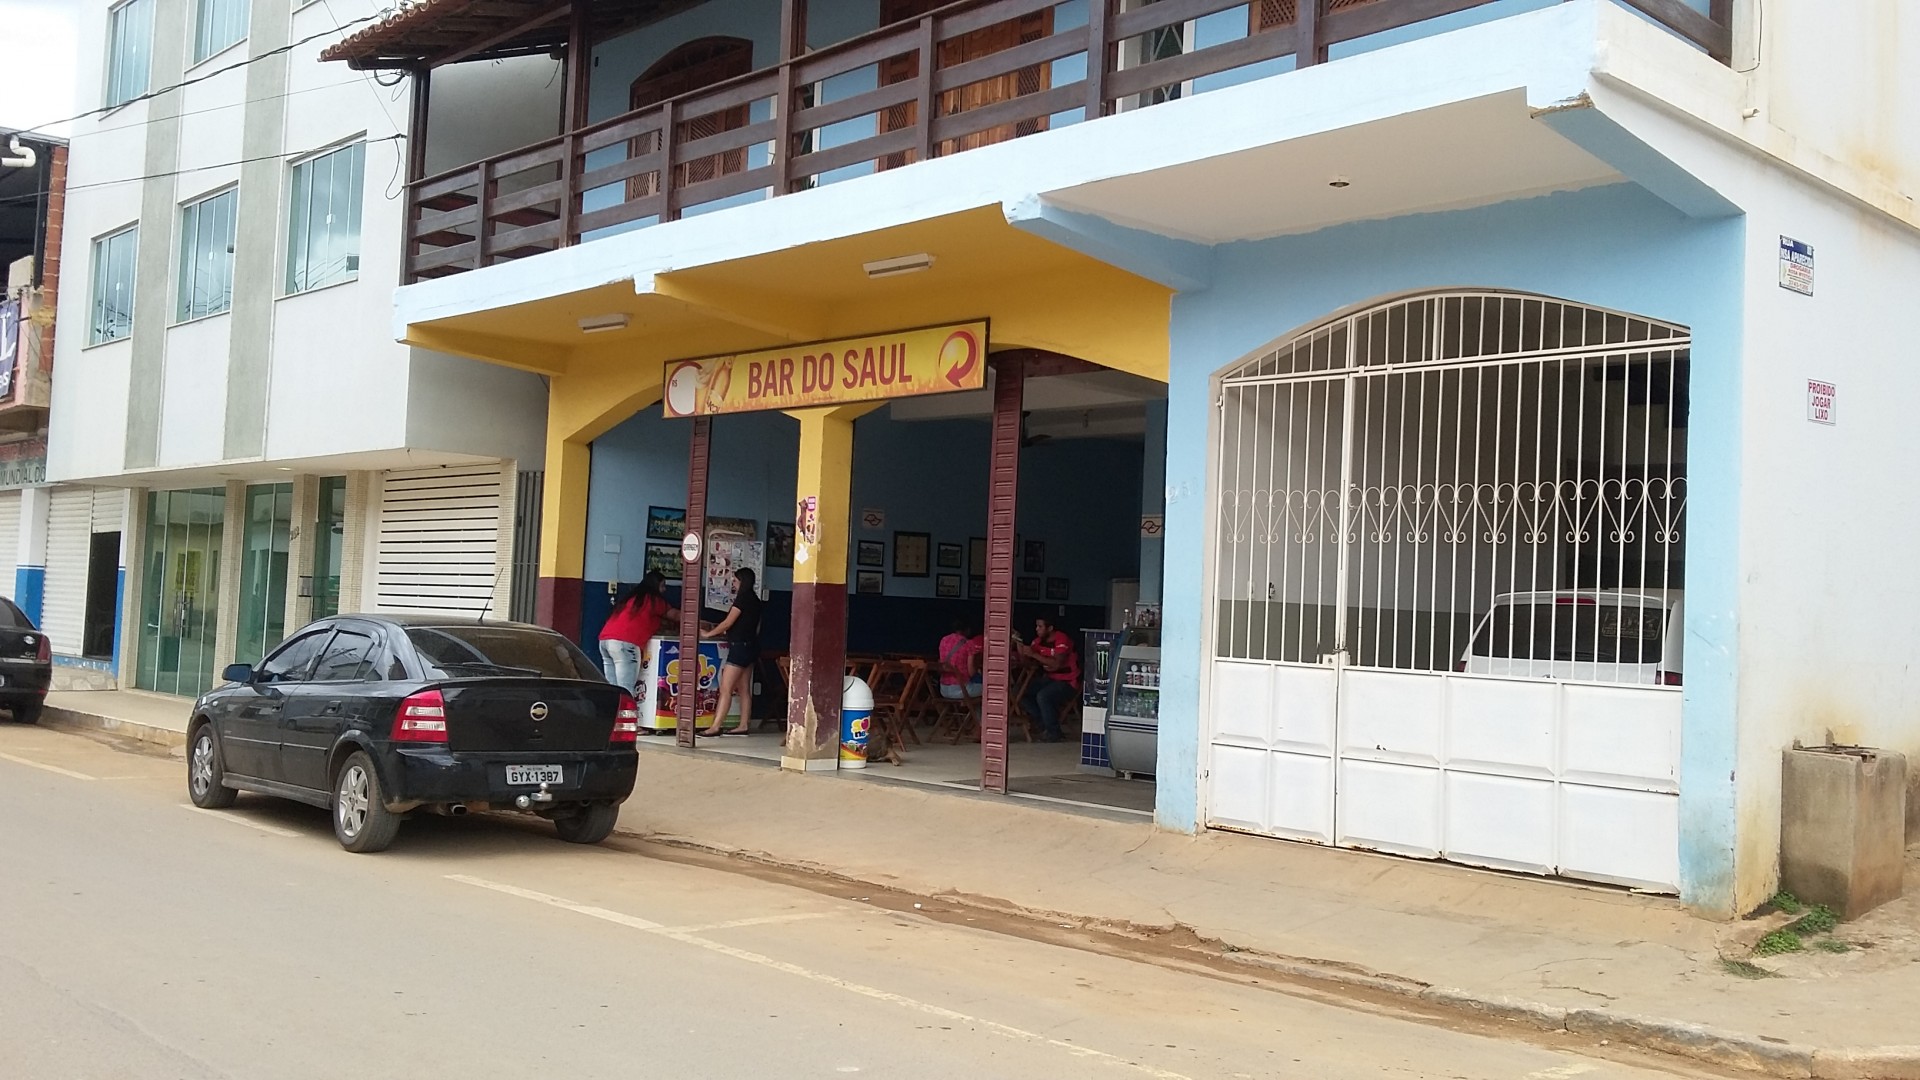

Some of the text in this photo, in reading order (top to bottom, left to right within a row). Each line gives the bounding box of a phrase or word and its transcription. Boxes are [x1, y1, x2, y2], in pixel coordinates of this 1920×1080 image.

[748, 342, 912, 399] BAR DO SAUL
[1808, 382, 1836, 397] PROIBIDO
[1811, 396, 1831, 409] JOGAR
[1815, 408, 1829, 420] LIXO
[0, 467, 33, 485] MUNDIAL
